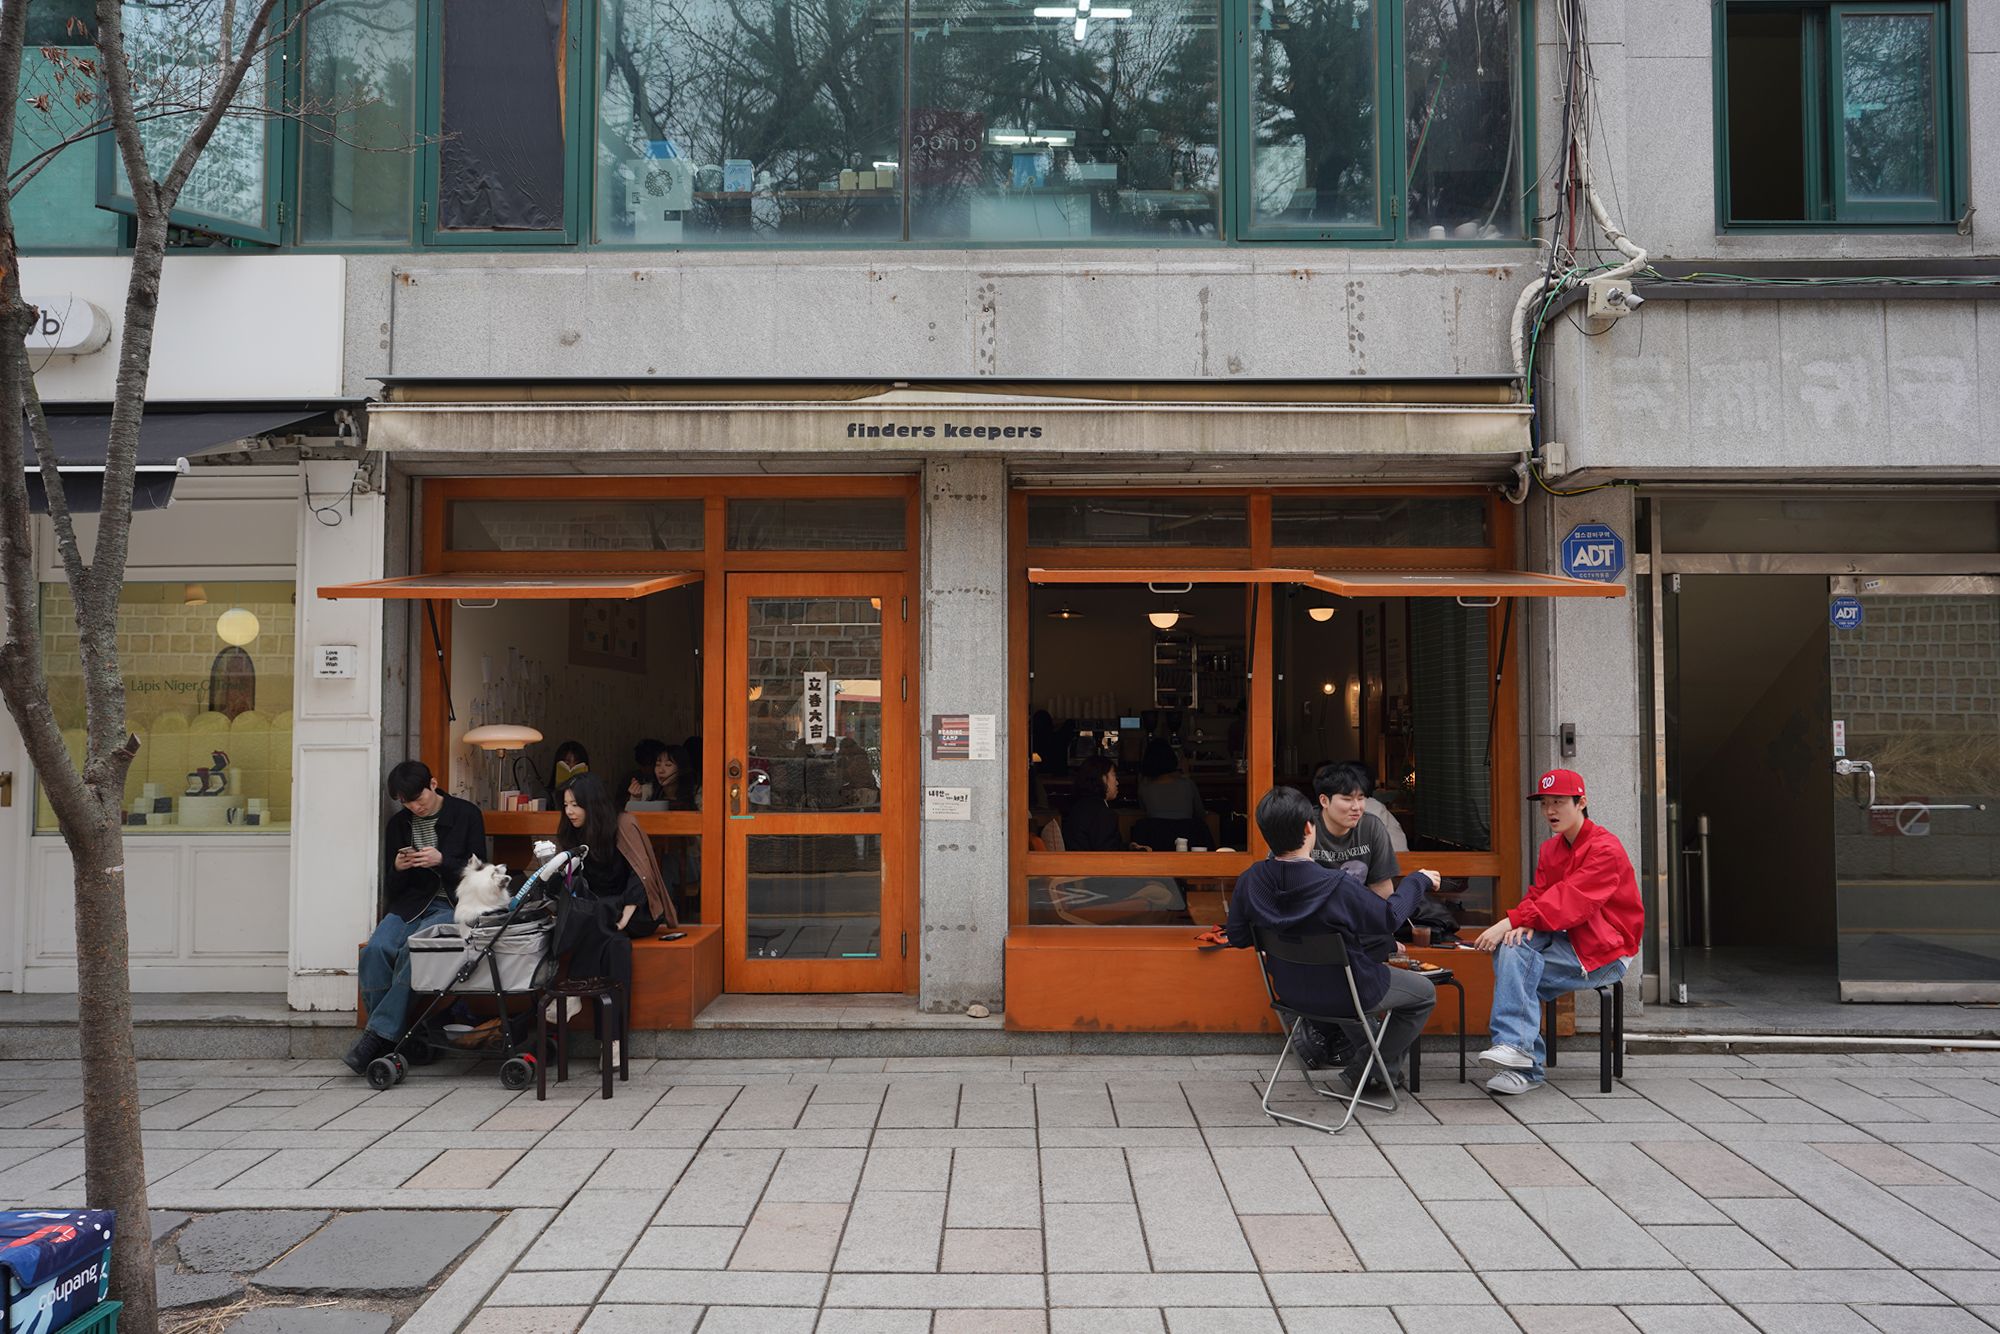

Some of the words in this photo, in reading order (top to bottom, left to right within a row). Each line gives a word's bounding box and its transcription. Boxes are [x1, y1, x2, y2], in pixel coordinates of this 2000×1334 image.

[847, 423, 936, 438] finders
[944, 423, 1043, 440] keepers
[1572, 544, 1615, 567] ADT
[1835, 607, 1859, 619] ADT
[808, 677, 823, 738] 立春大吉
[1541, 774, 1555, 789] W
[40, 1262, 98, 1311] coupang
